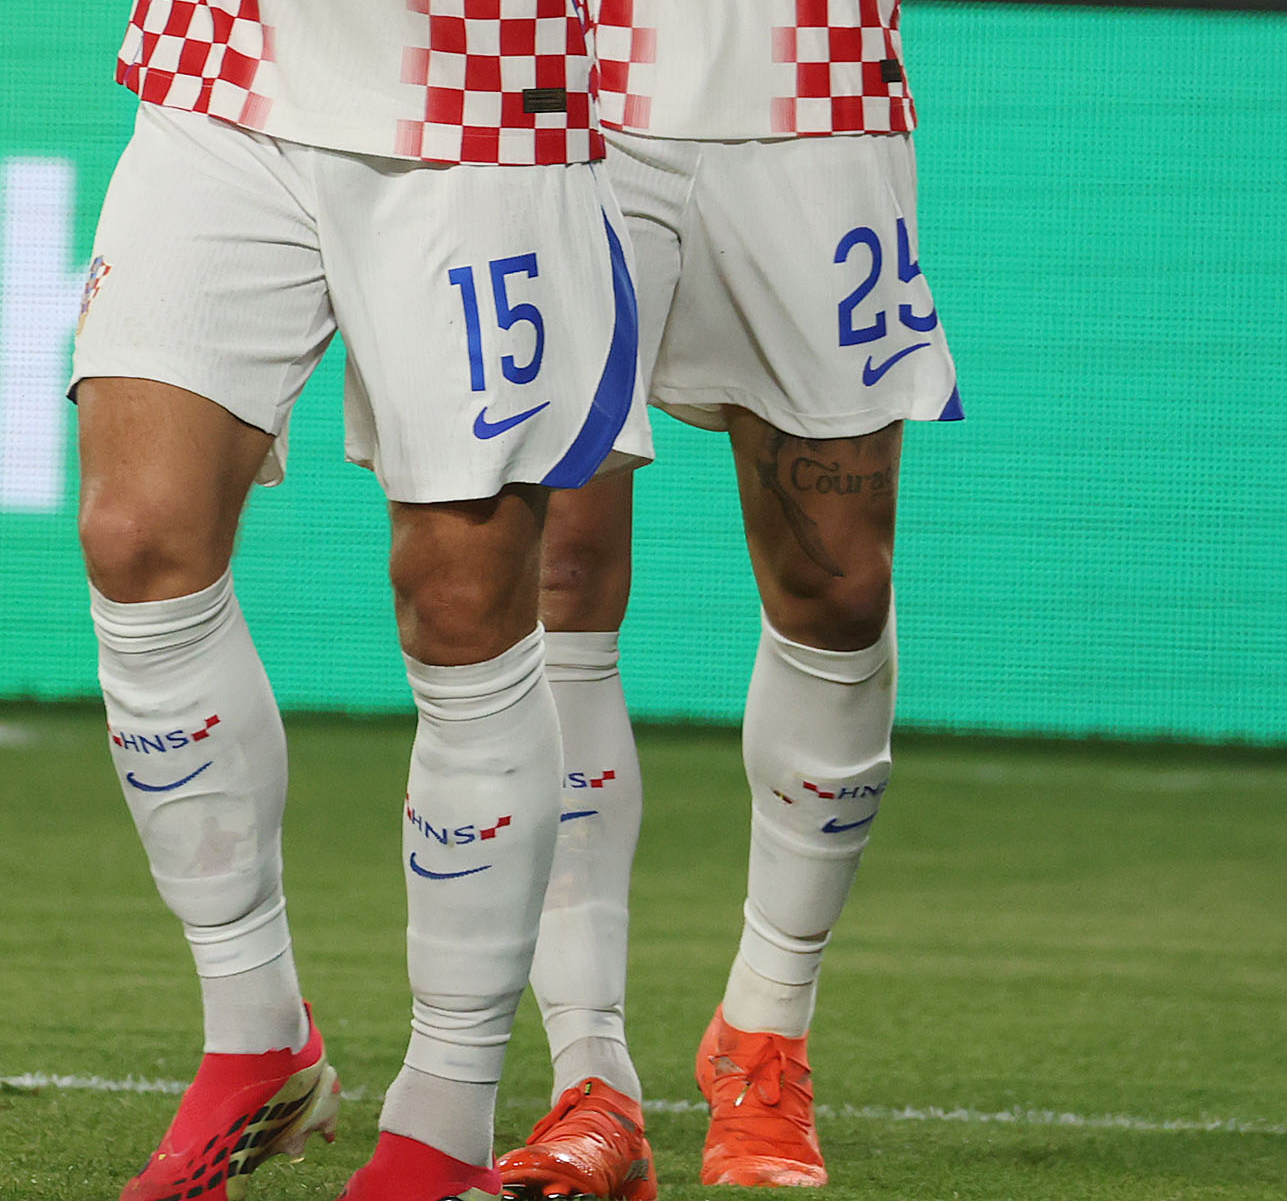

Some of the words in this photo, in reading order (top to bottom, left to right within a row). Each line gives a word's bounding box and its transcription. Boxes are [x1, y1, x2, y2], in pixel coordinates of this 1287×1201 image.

[833, 216, 938, 347] 25
[448, 251, 545, 393] 15
[791, 456, 891, 500] Coura
[120, 729, 190, 754] HNS
[412, 808, 476, 845] HNS
